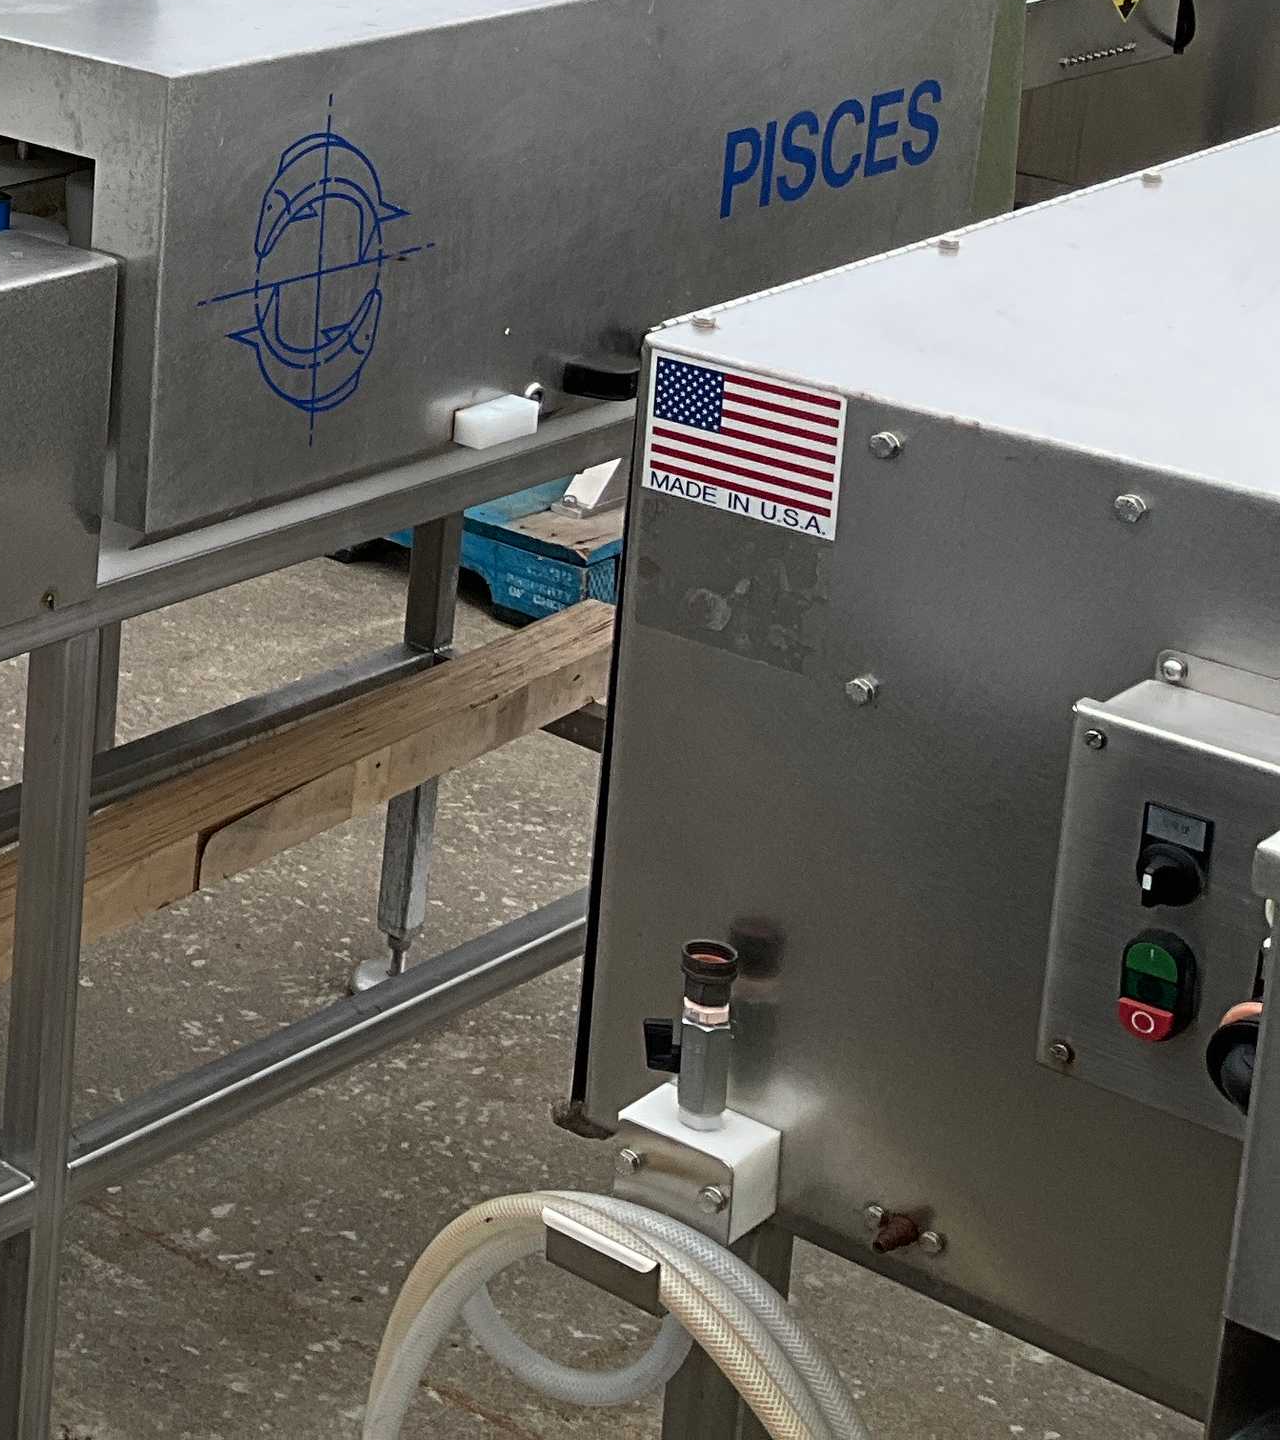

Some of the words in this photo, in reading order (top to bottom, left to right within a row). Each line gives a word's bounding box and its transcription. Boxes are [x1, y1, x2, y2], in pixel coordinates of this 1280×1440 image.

[720, 79, 942, 219] PISCES
[650, 470, 717, 505] MADE
[728, 492, 749, 513] IN
[761, 501, 826, 536] U.S.A.
